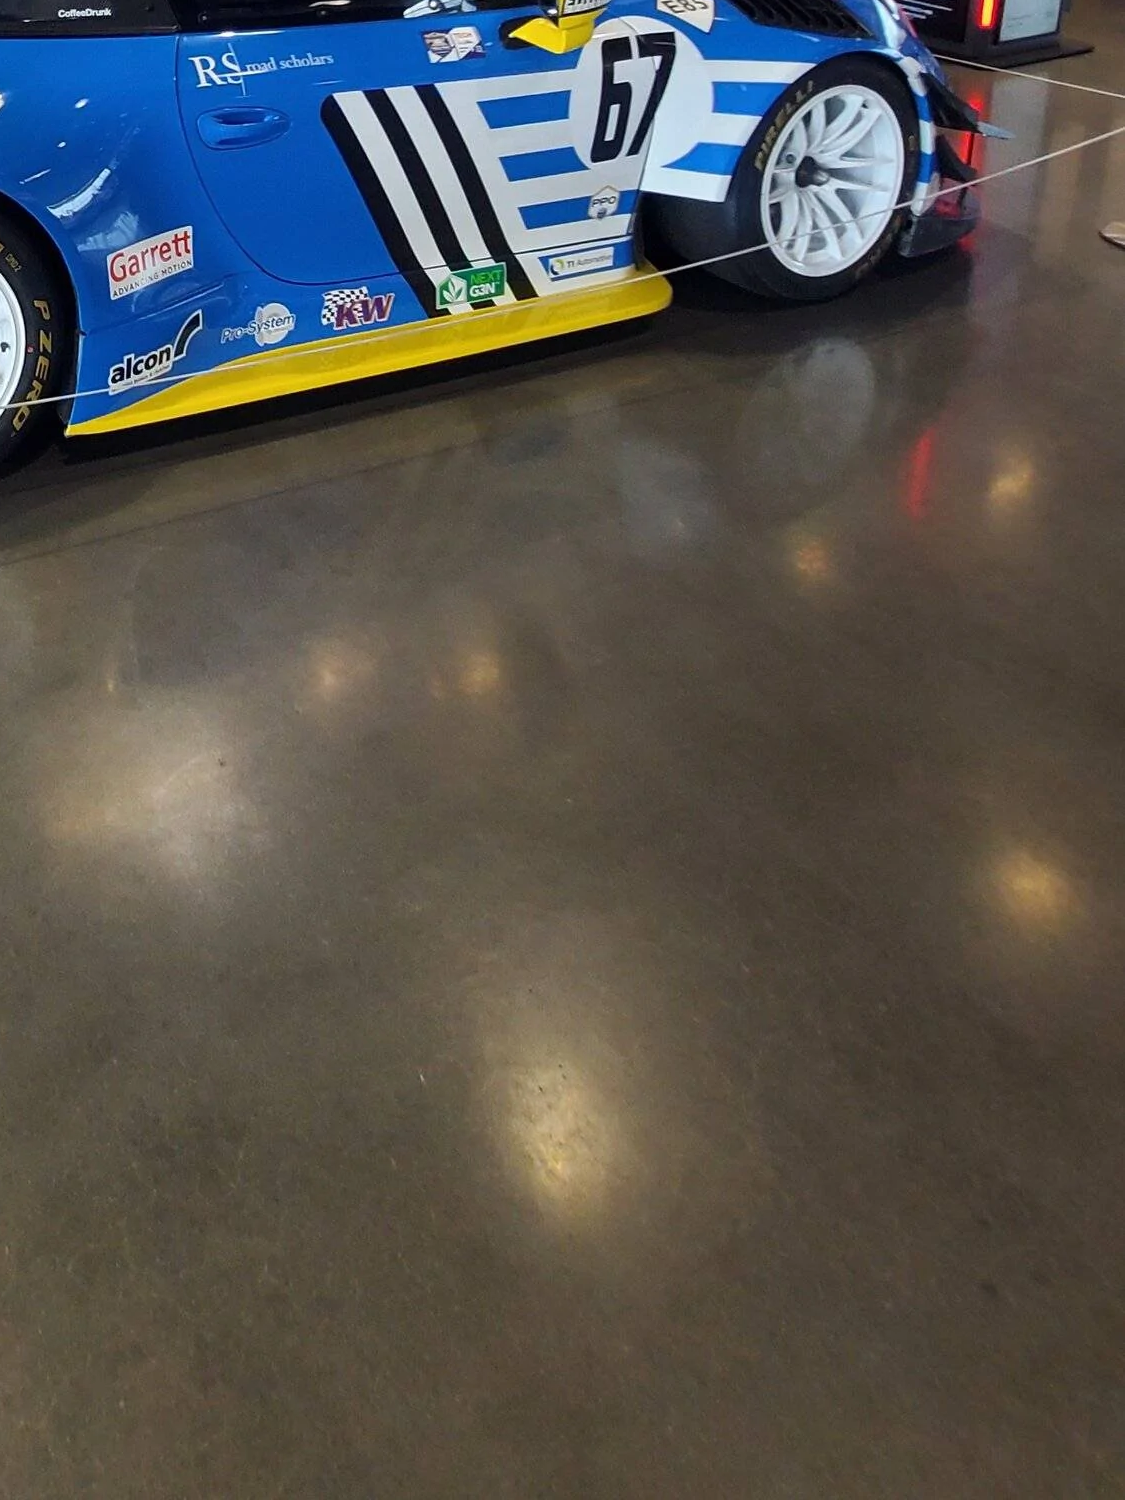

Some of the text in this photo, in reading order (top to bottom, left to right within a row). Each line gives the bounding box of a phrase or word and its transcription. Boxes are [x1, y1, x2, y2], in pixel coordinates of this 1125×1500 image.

[58, 8, 111, 19] CoffeeDrunk
[279, 53, 334, 69] scholars
[590, 31, 676, 163] 67
[592, 196, 616, 207] PPO
[109, 231, 191, 283] Garrett
[112, 259, 193, 298] ADVANCING MOTION
[471, 269, 502, 284] NEXT
[221, 314, 295, 343] Pro-System
[334, 293, 395, 330] KW
[11, 299, 52, 430] P ZERO
[110, 346, 171, 384] alcon
